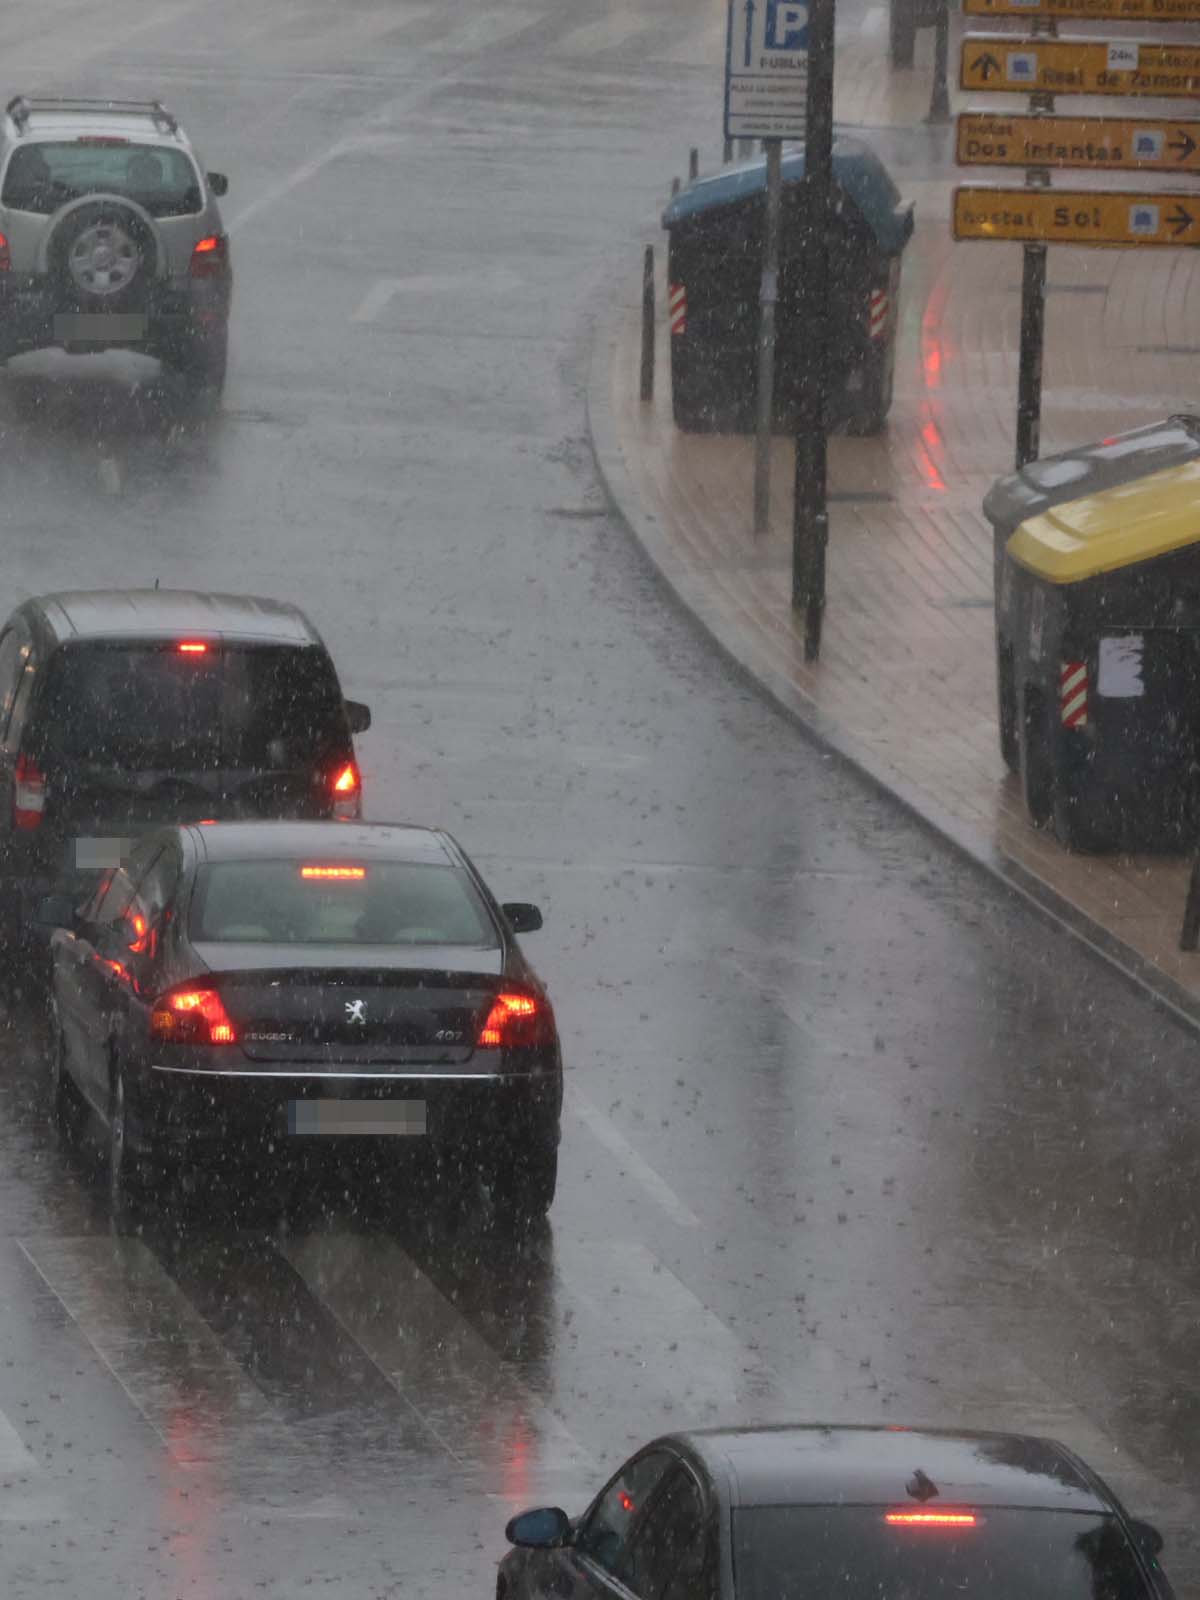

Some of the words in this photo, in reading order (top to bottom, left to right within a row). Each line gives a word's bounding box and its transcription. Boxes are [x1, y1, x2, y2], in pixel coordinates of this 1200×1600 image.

[775, 2, 808, 46] P
[1095, 70, 1119, 87] de
[967, 140, 1007, 157] Dos
[1053, 207, 1101, 228] Sol
[243, 1032, 294, 1041] PEUGEOT
[435, 1029, 464, 1041] 407
